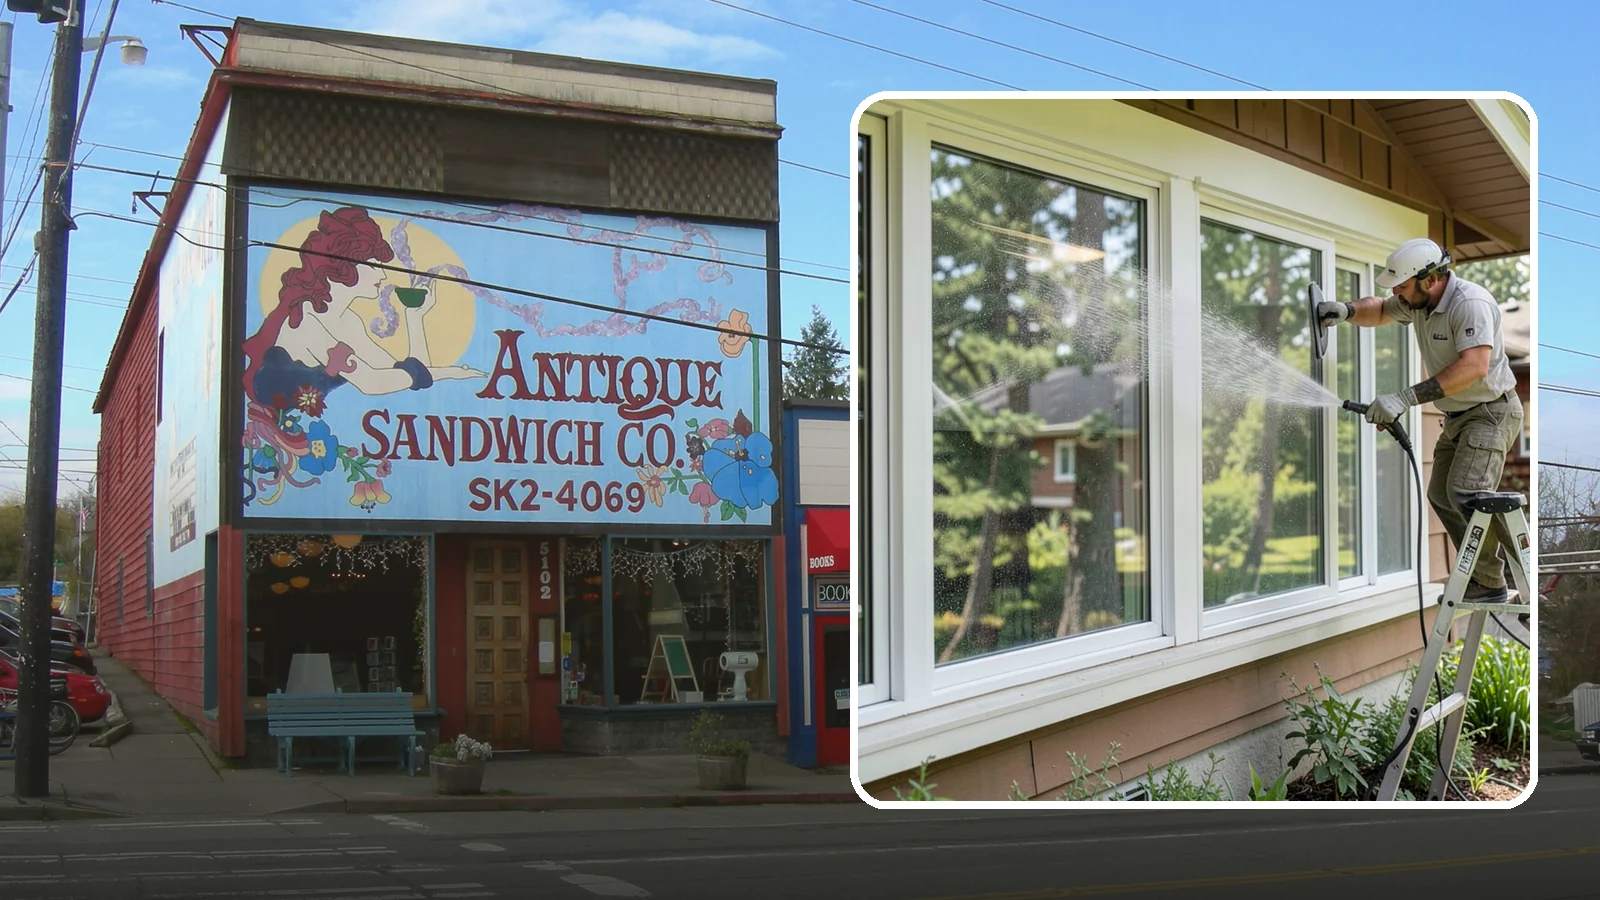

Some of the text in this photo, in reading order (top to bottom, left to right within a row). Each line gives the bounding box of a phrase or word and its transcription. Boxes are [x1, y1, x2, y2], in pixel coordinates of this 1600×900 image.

[476, 329, 723, 420] ANTIQUE
[362, 408, 684, 469] SANDWICH CO.
[468, 477, 646, 513] SK2-4069
[539, 542, 551, 600] 5102
[809, 555, 834, 569] BOOKS
